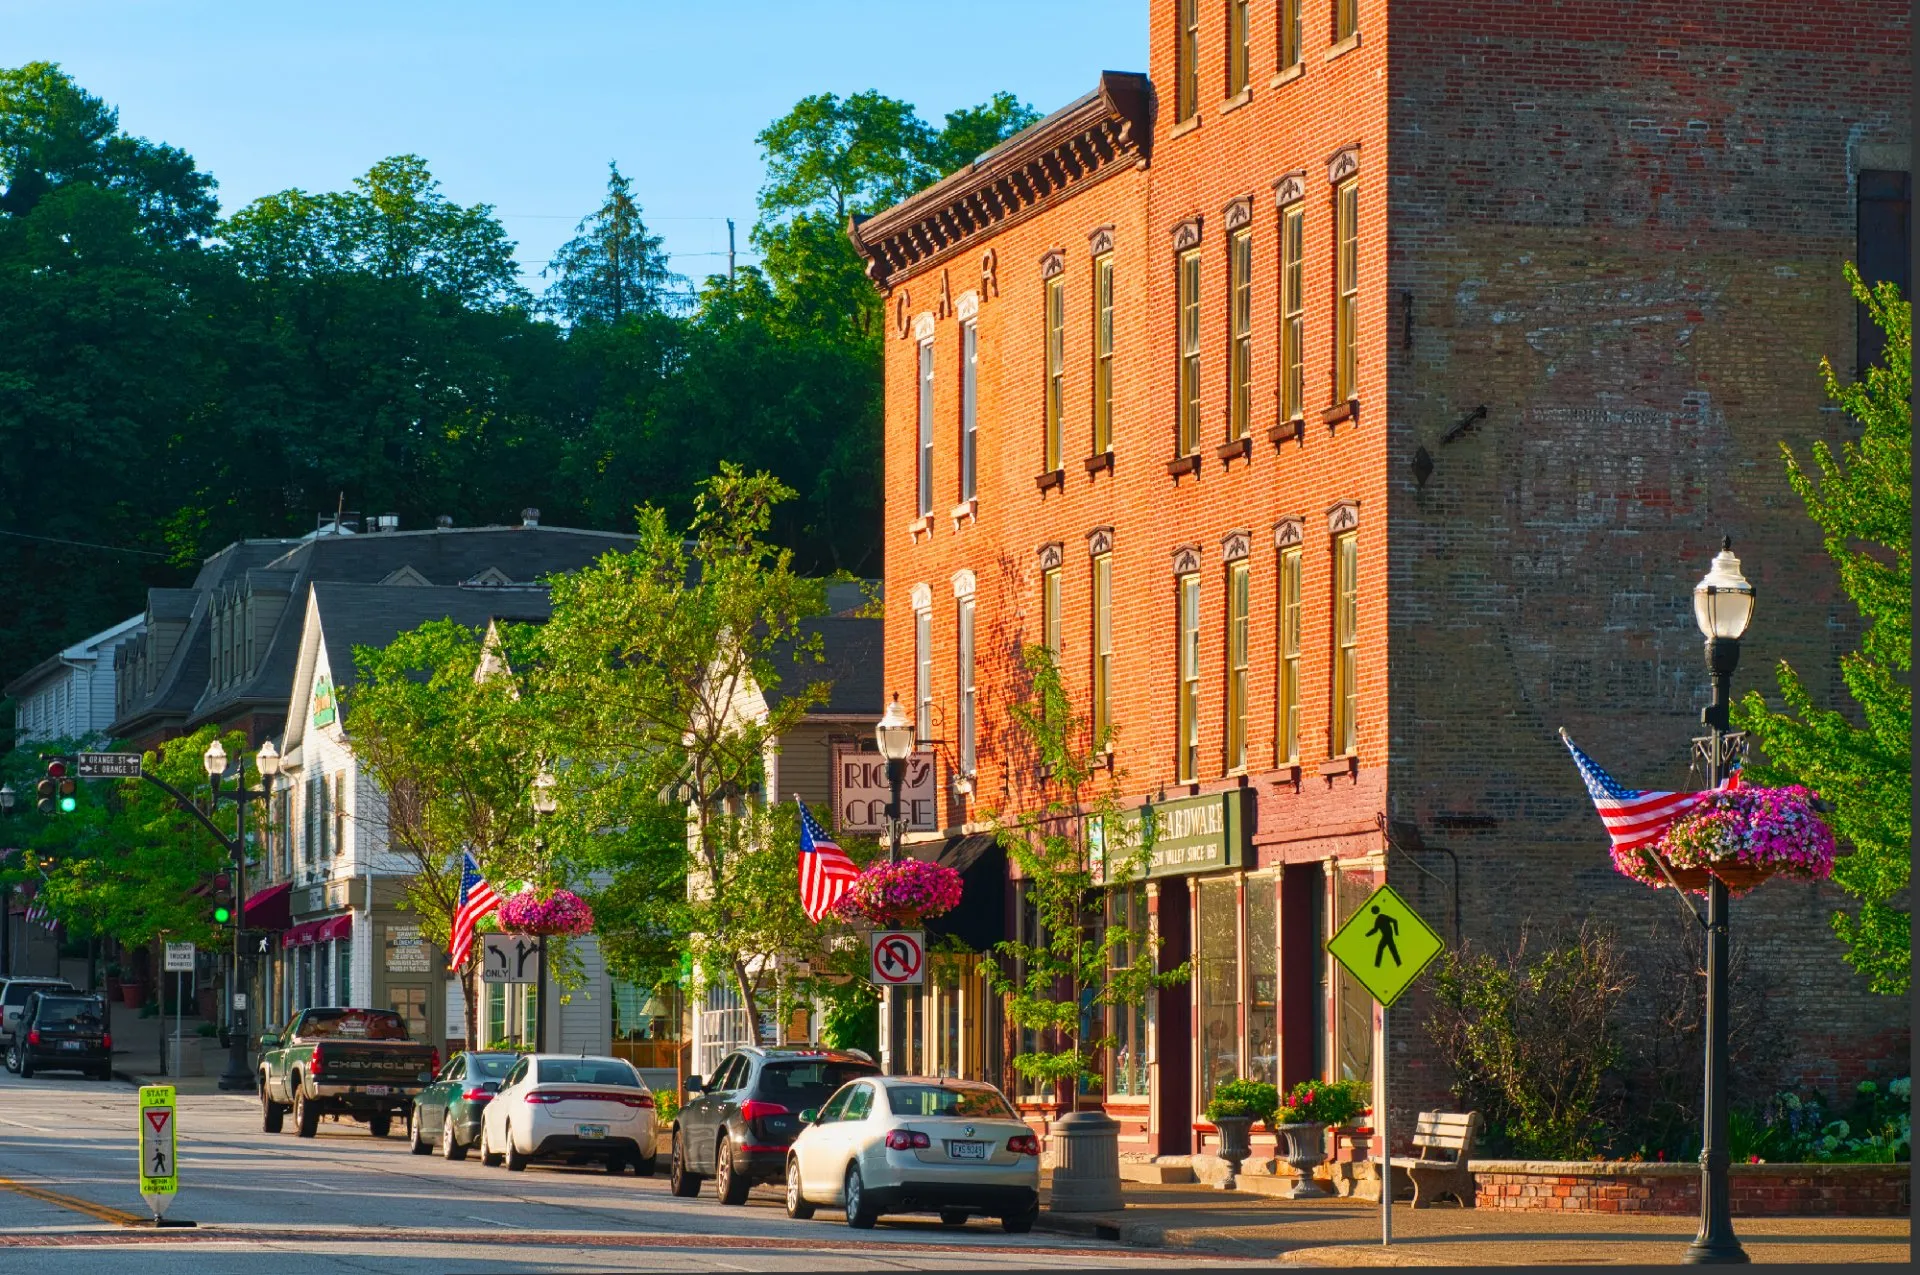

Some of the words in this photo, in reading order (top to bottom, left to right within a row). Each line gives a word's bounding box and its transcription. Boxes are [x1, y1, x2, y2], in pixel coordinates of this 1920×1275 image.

[89, 755, 114, 764] ORANGE
[118, 756, 126, 764] ST
[102, 765, 127, 773] ORANGE
[131, 765, 138, 773] ST
[1187, 845, 1205, 862] SINCE
[485, 969, 508, 977] ONLY
[328, 1061, 425, 1070] CHEVROLET
[146, 1089, 168, 1097] STATE
